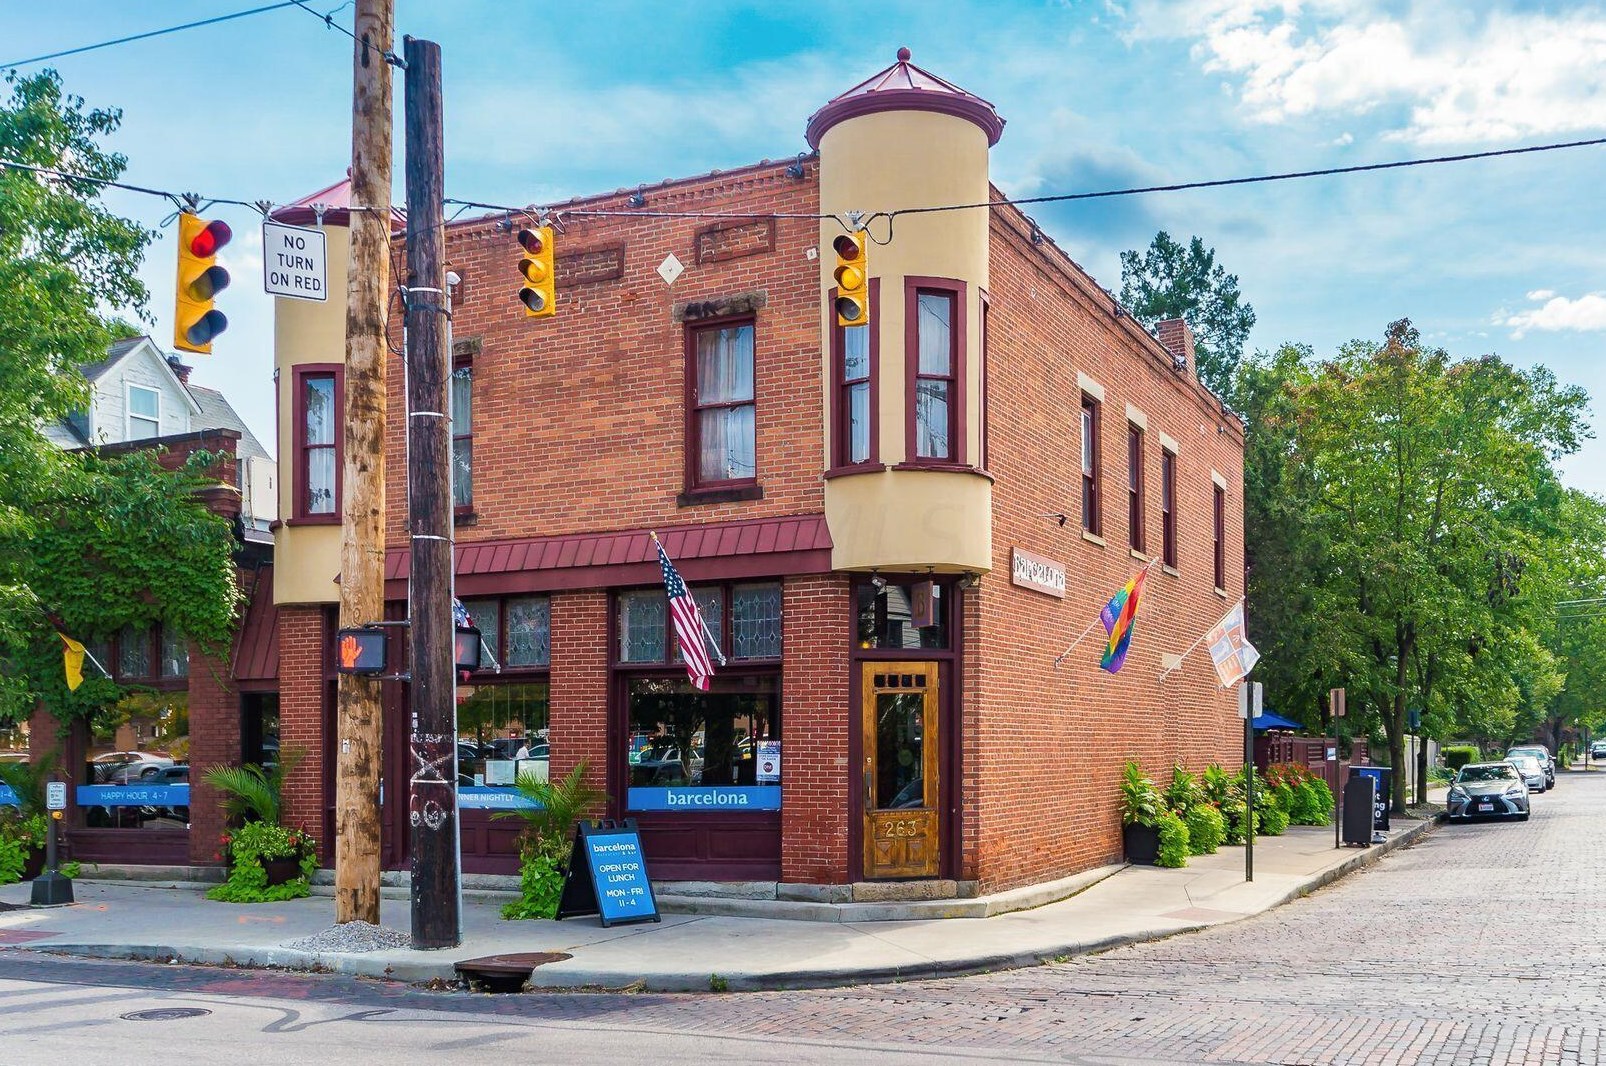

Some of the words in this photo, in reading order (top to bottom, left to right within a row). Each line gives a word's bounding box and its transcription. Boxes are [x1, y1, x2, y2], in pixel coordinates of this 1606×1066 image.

[284, 235, 305, 250] NO
[277, 253, 314, 271] TURN
[270, 271, 290, 287] ON
[295, 276, 321, 291] RED
[100, 791, 125, 800] HAPPY
[126, 791, 149, 800] HOUR
[458, 793, 479, 802] NNER
[480, 793, 515, 802] NIGHTLY
[667, 790, 748, 805] barcelona
[884, 820, 917, 838] 263
[593, 843, 636, 852] barcelona
[600, 864, 622, 872] OPEN
[623, 863, 639, 871] FOR
[608, 873, 635, 882] LUNCH
[606, 889, 626, 898] MON
[631, 887, 644, 895] FRI
